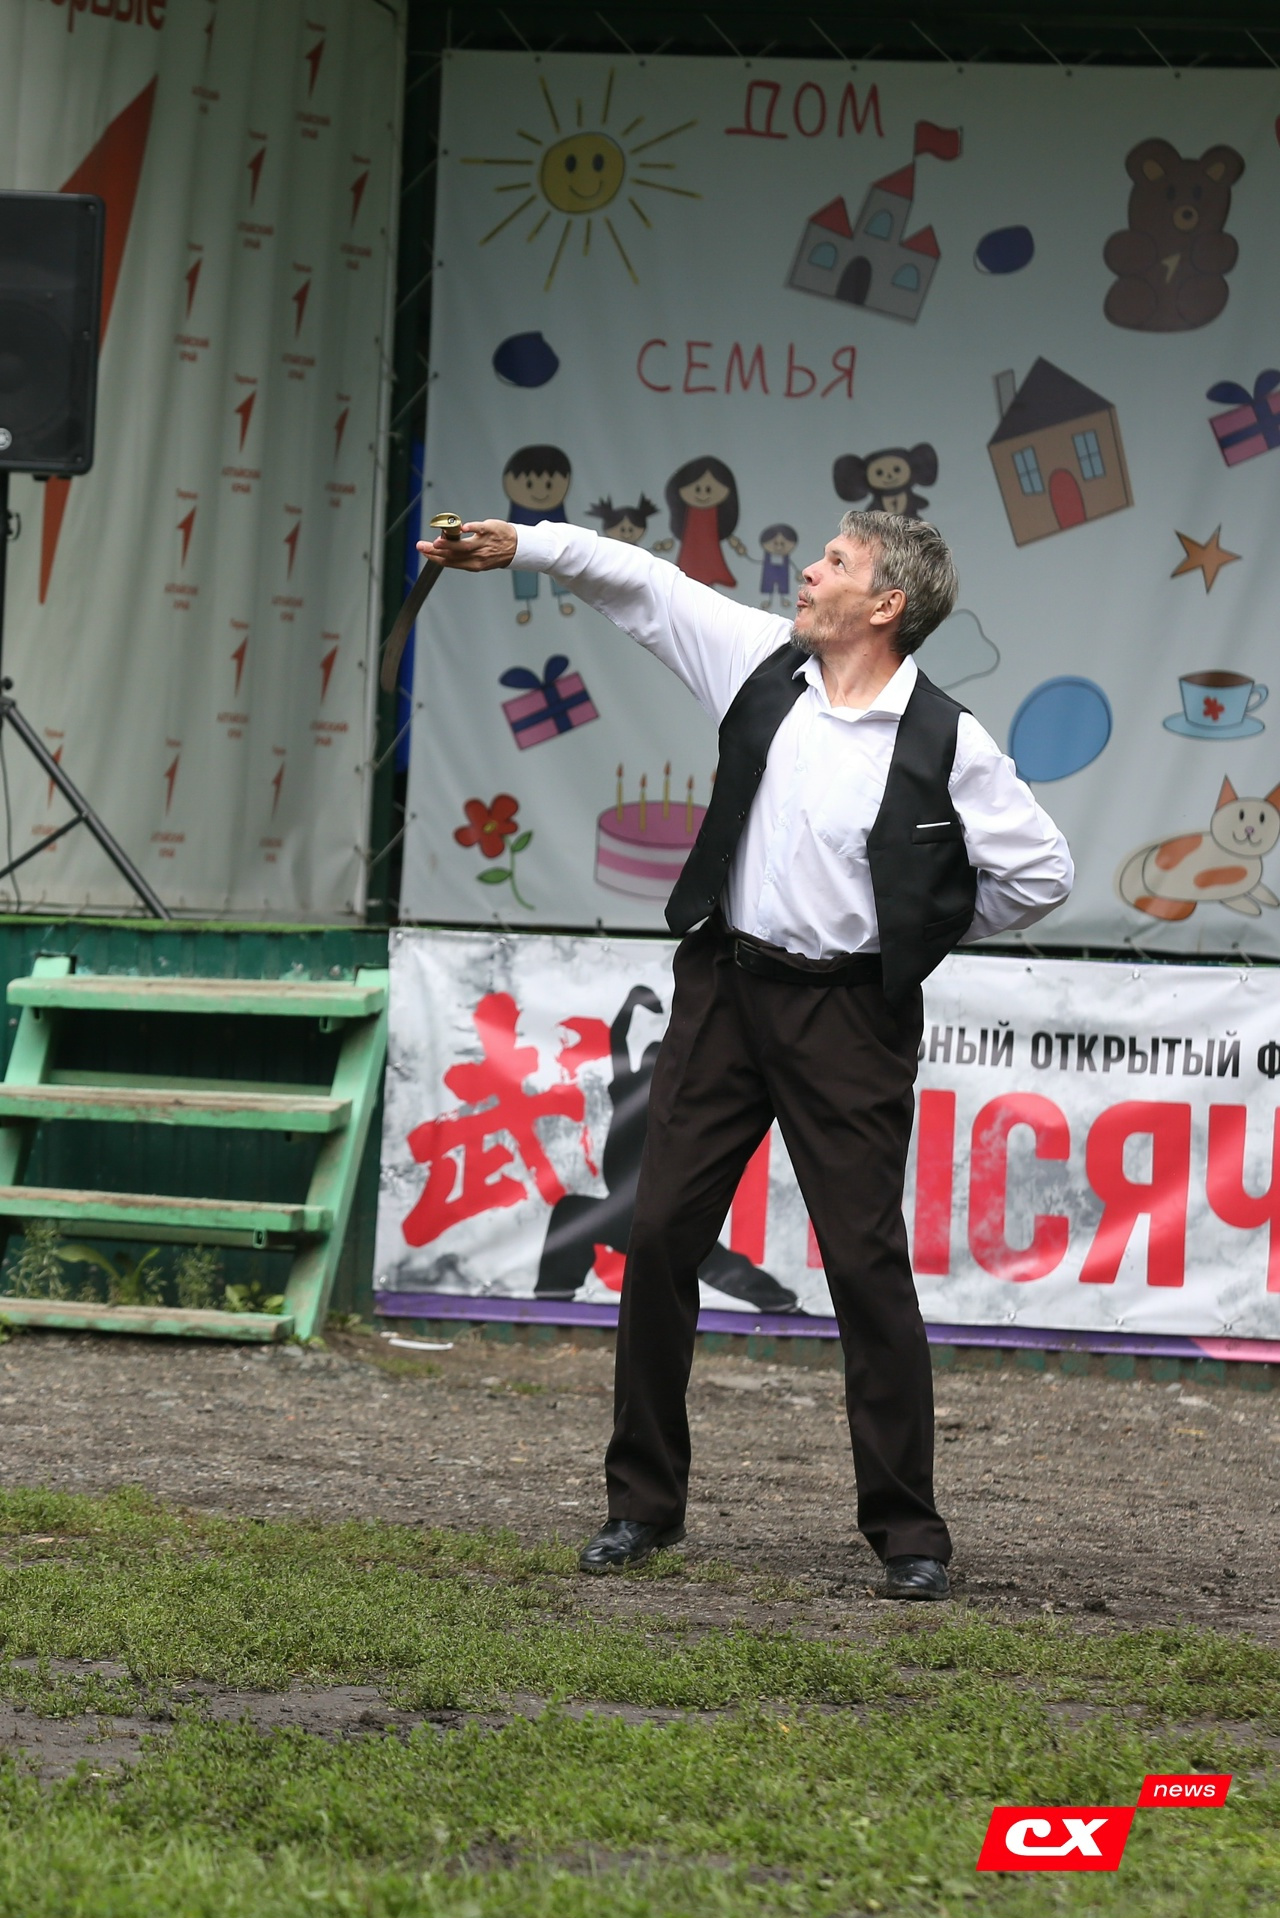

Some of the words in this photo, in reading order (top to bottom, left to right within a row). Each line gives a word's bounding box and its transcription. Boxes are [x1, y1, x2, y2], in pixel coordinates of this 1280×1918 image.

[725, 79, 885, 139] ДОМ
[637, 338, 858, 399] СЕМЬЯ
[1030, 1029, 1242, 1079] ОТКРЫТЫЙ
